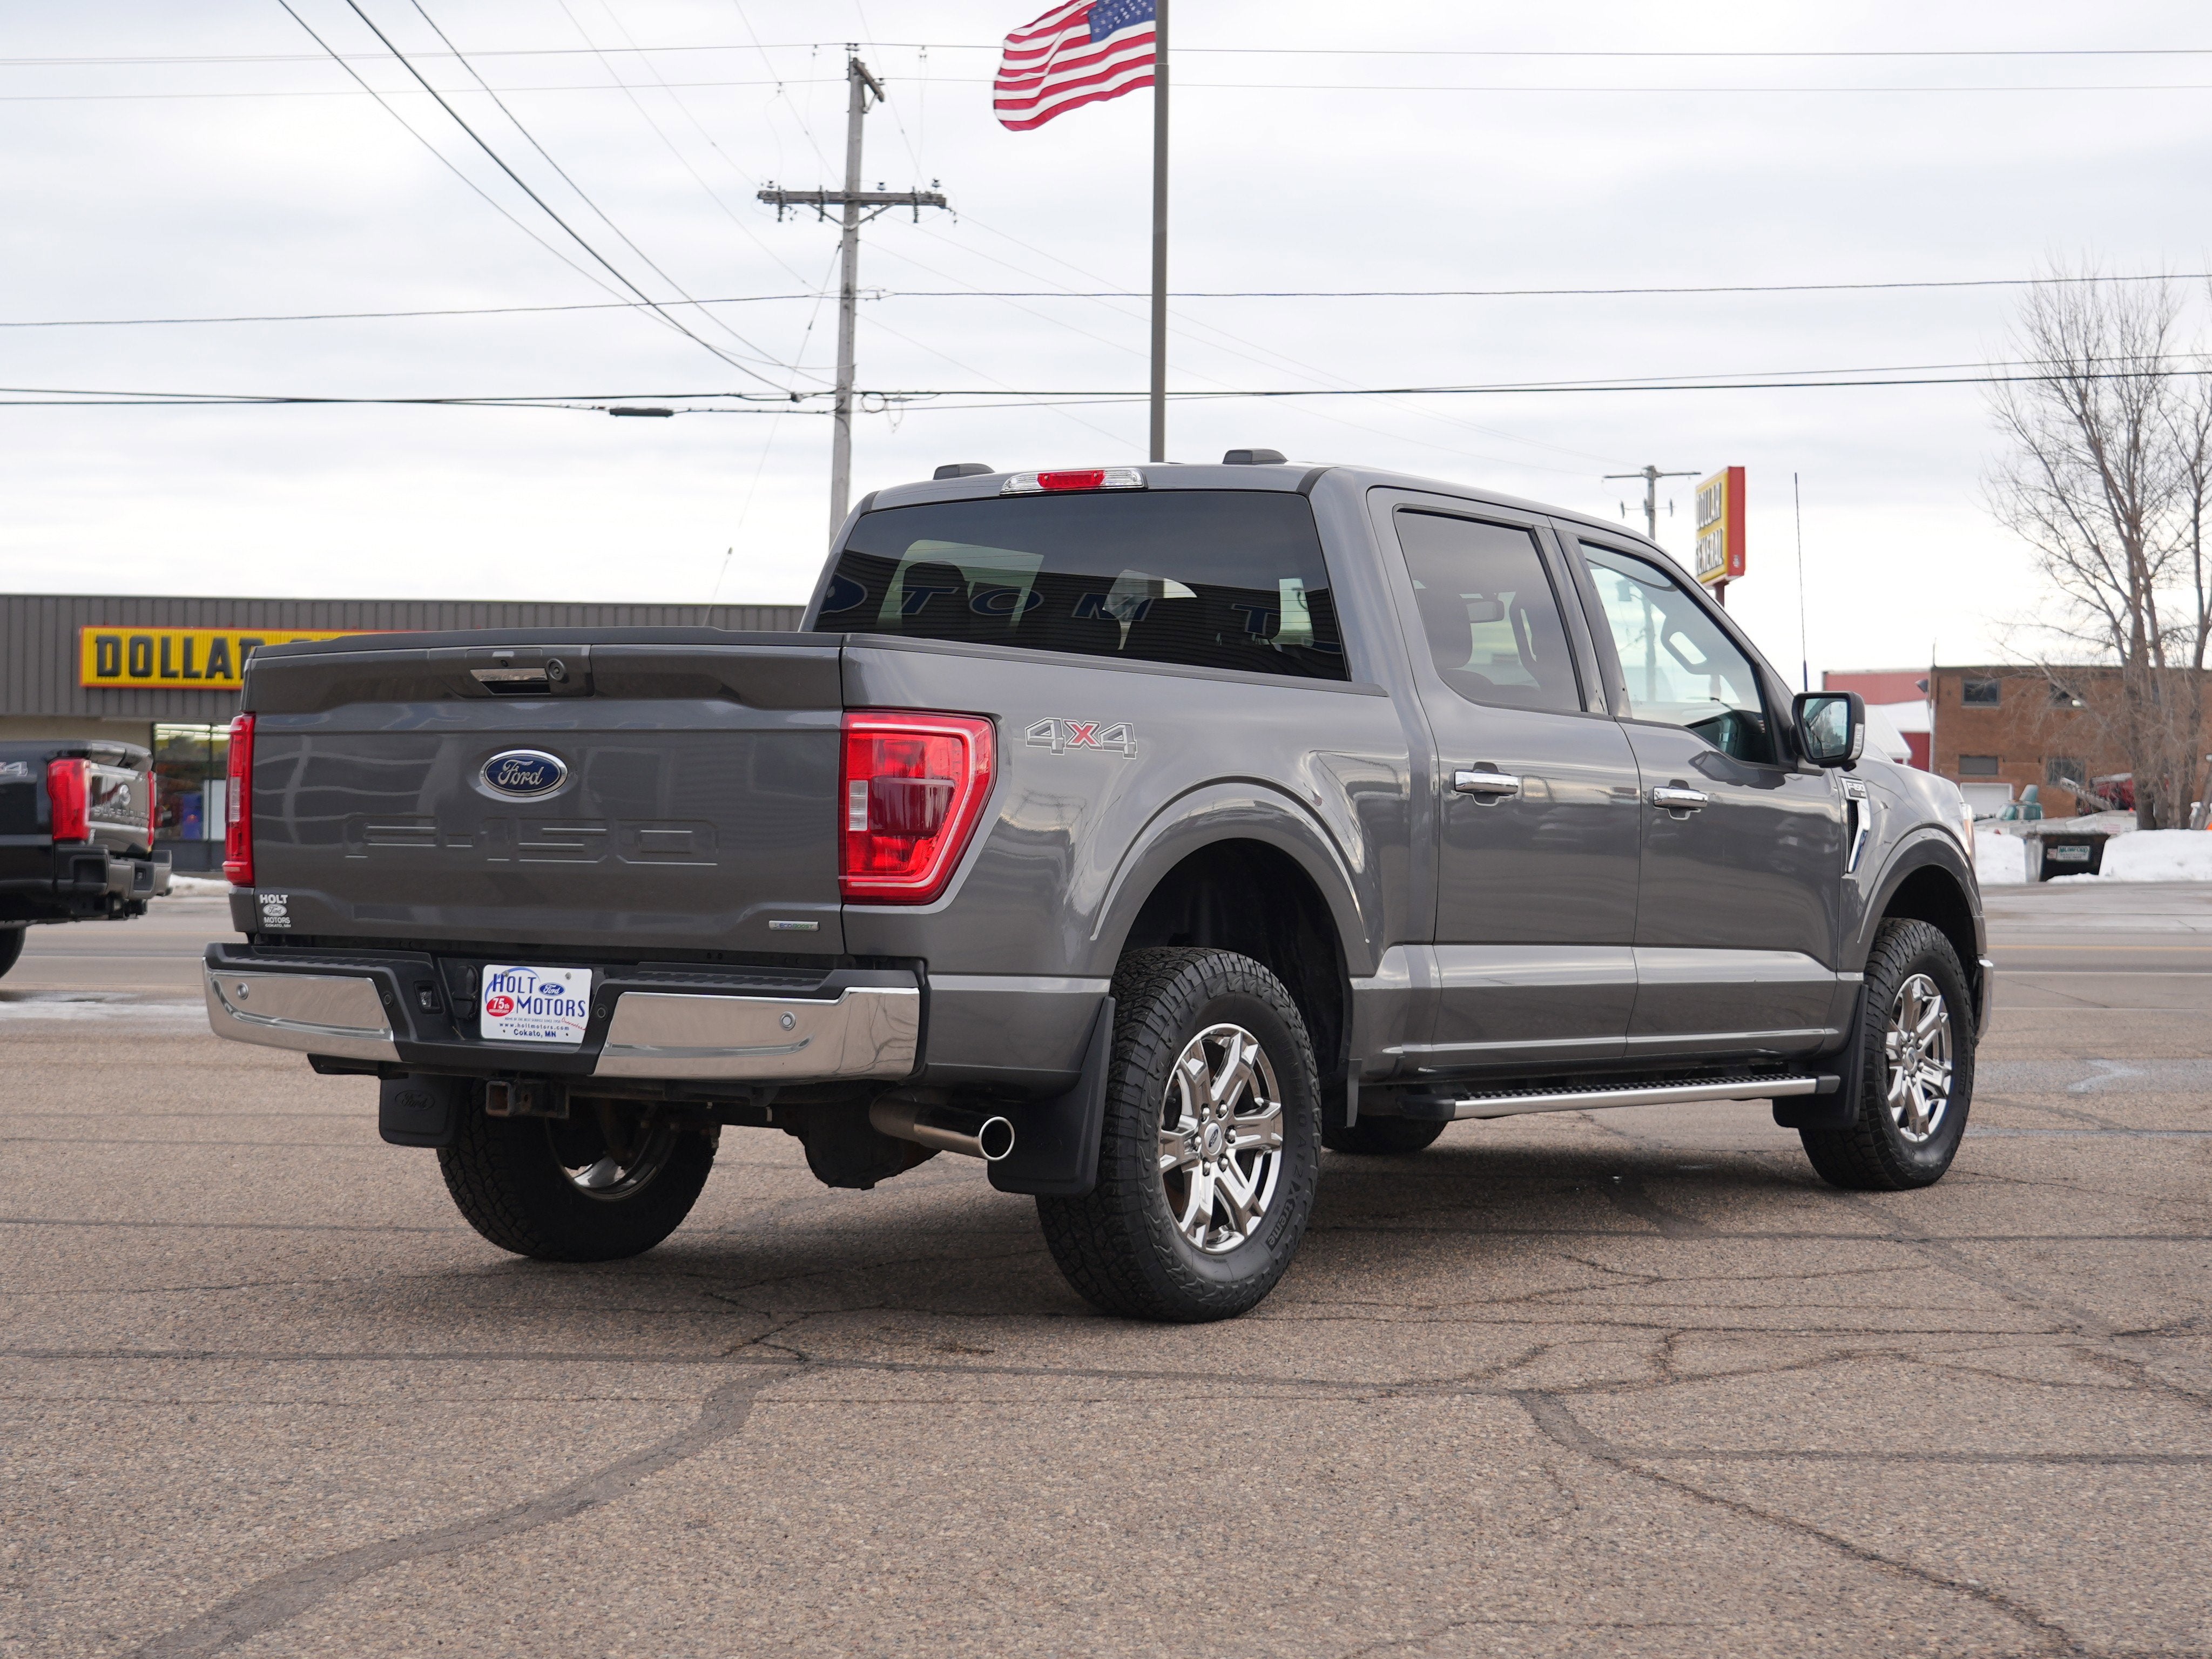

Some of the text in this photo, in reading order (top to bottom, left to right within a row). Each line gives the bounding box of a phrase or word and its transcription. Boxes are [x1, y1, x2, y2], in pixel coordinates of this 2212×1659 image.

[498, 759, 545, 786] Ford
[259, 894, 288, 904] HOLT
[268, 906, 282, 914] Ford
[493, 973, 537, 994] HOLT
[543, 983, 560, 995] Ford
[493, 997, 510, 1009] 75th
[516, 995, 586, 1017] MOTORS
[500, 1022, 569, 1030] www.holtmotors.com
[514, 1029, 543, 1038] Cokato,
